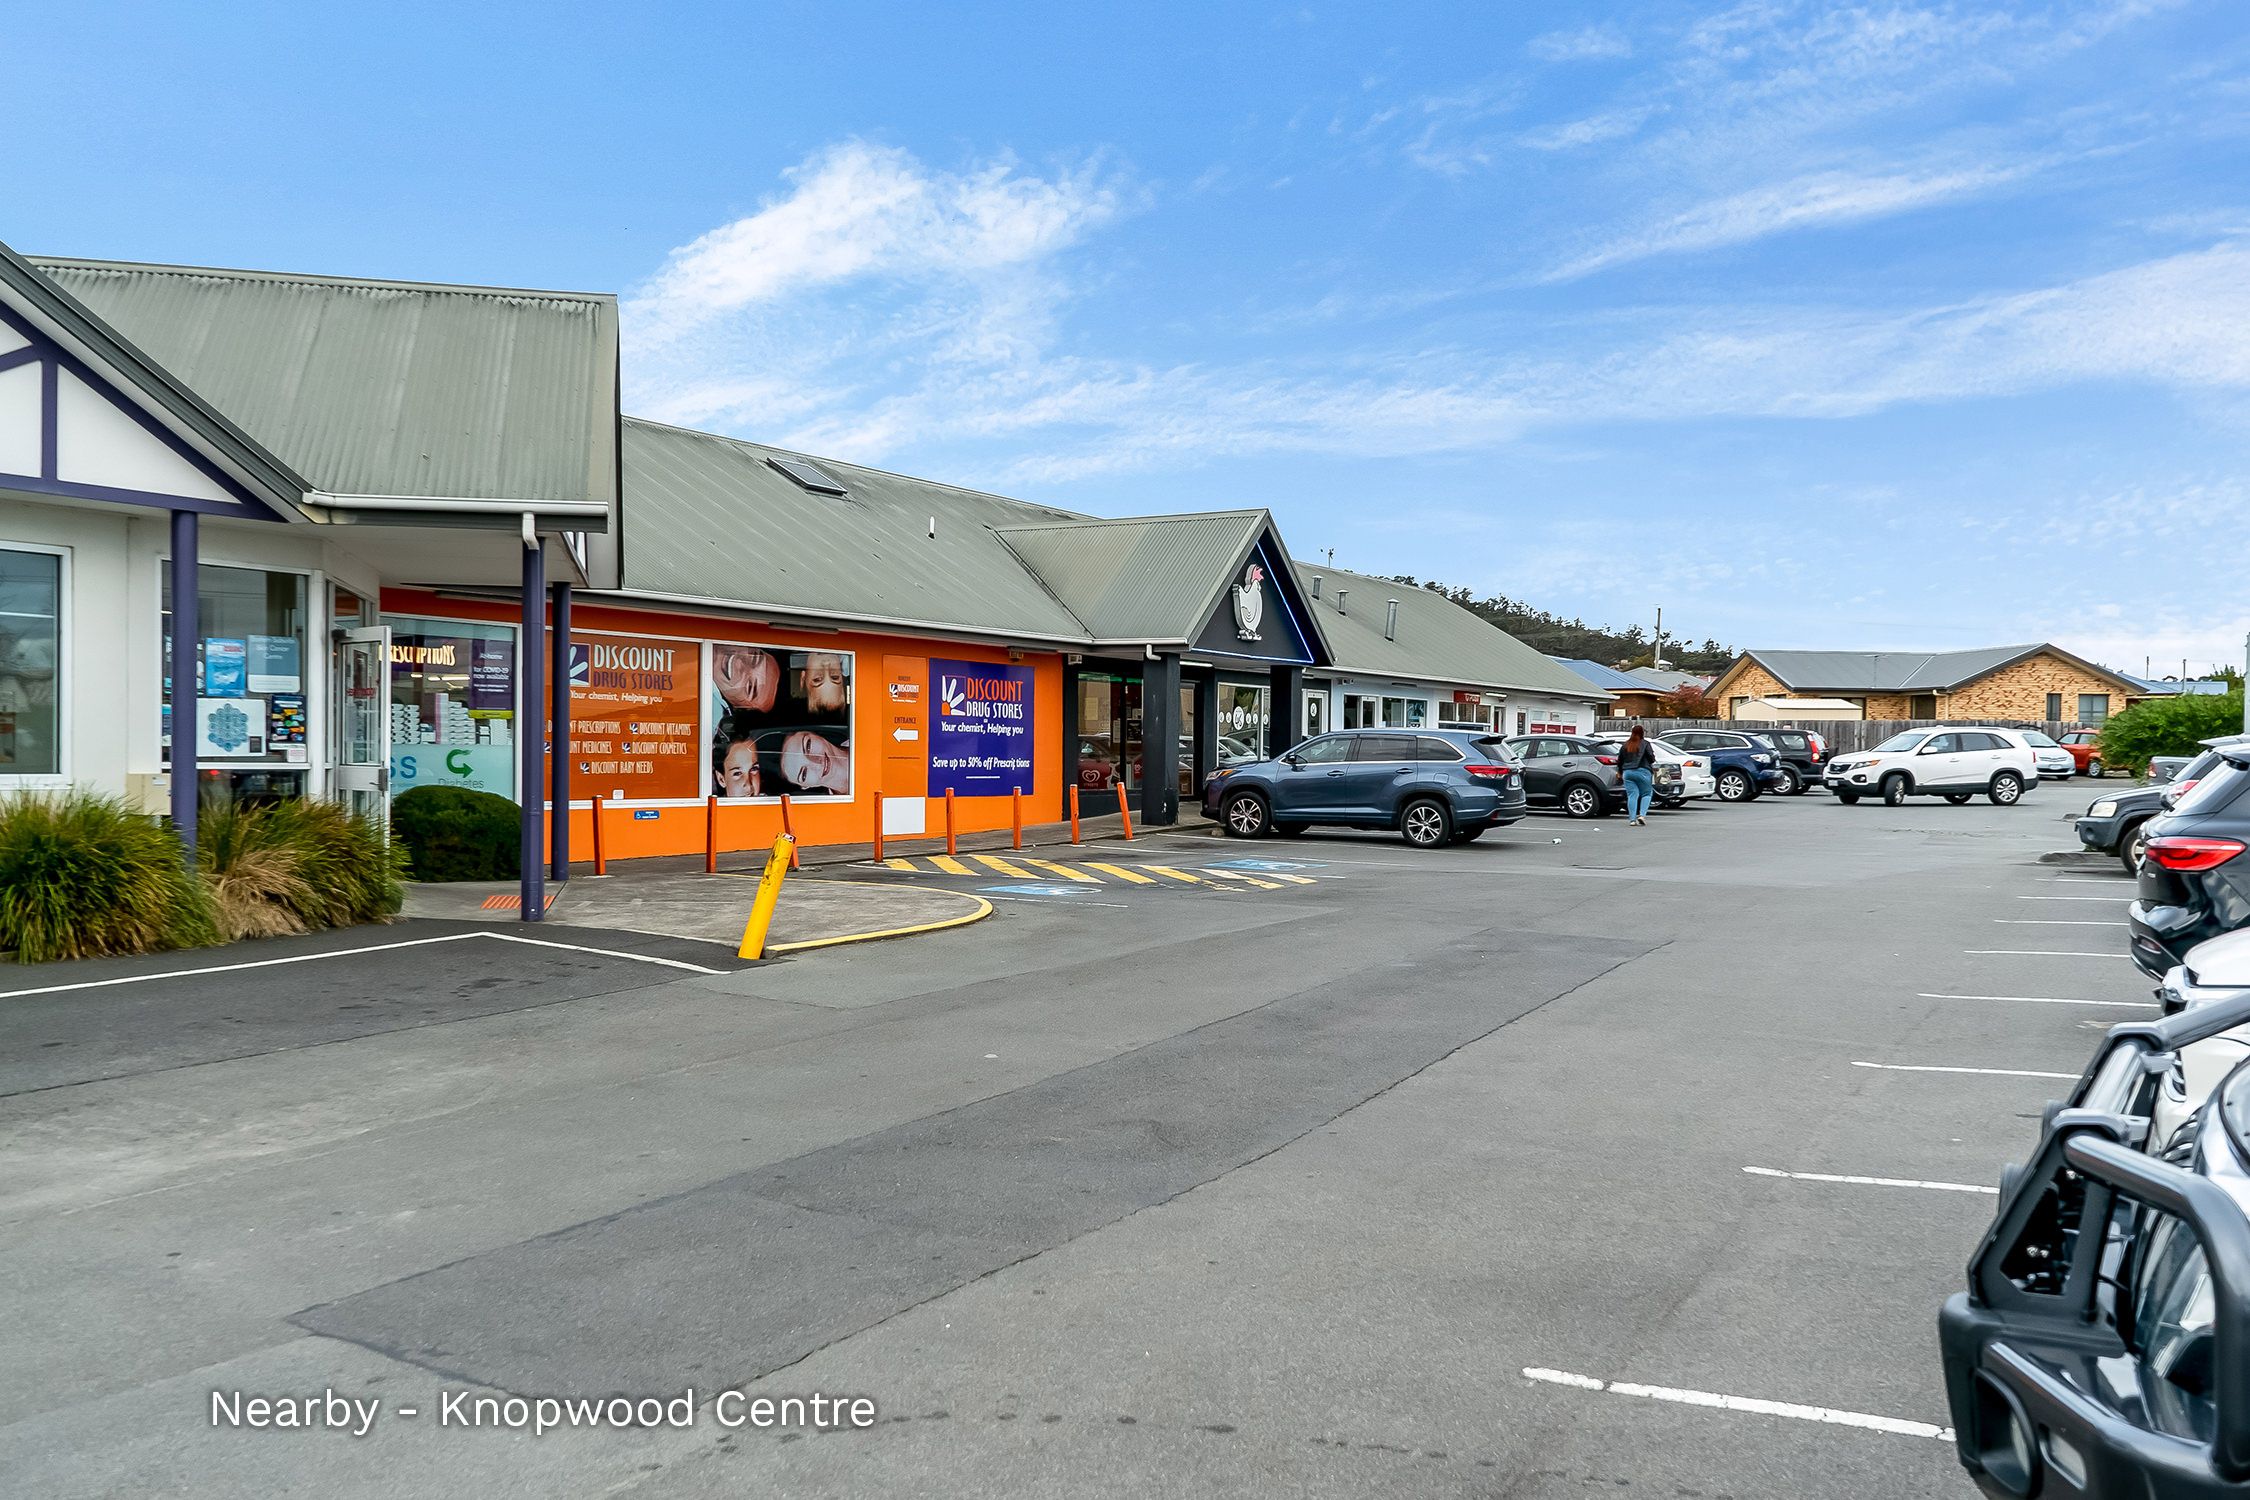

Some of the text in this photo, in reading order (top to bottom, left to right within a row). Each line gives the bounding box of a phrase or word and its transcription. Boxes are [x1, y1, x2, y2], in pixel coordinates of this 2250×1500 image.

[594, 644, 676, 672] DISCOUNT
[482, 666, 509, 674] COVID-19
[593, 671, 673, 691] DRUG STORES
[967, 677, 1024, 702] DISCOUNT
[570, 689, 663, 705] Your chemist, Helping you
[966, 701, 1023, 720] DRUG STORES
[578, 720, 621, 734] PRESCRIPTIONS
[894, 716, 916, 724] ENTRANCE
[640, 722, 692, 736] DISCOUNT VITAMINS
[941, 721, 1024, 736] Your chemist, Helping you
[582, 740, 613, 754] MEDICINES
[632, 742, 687, 755] DISCOUNT COSMETICS
[591, 761, 654, 774] DISCOUNT BABY NEEDS
[932, 756, 948, 768] Save
[949, 758, 958, 771] up
[959, 757, 967, 768] to
[967, 756, 982, 768] 50%
[983, 756, 993, 771] off
[438, 778, 485, 789] Diabetes
